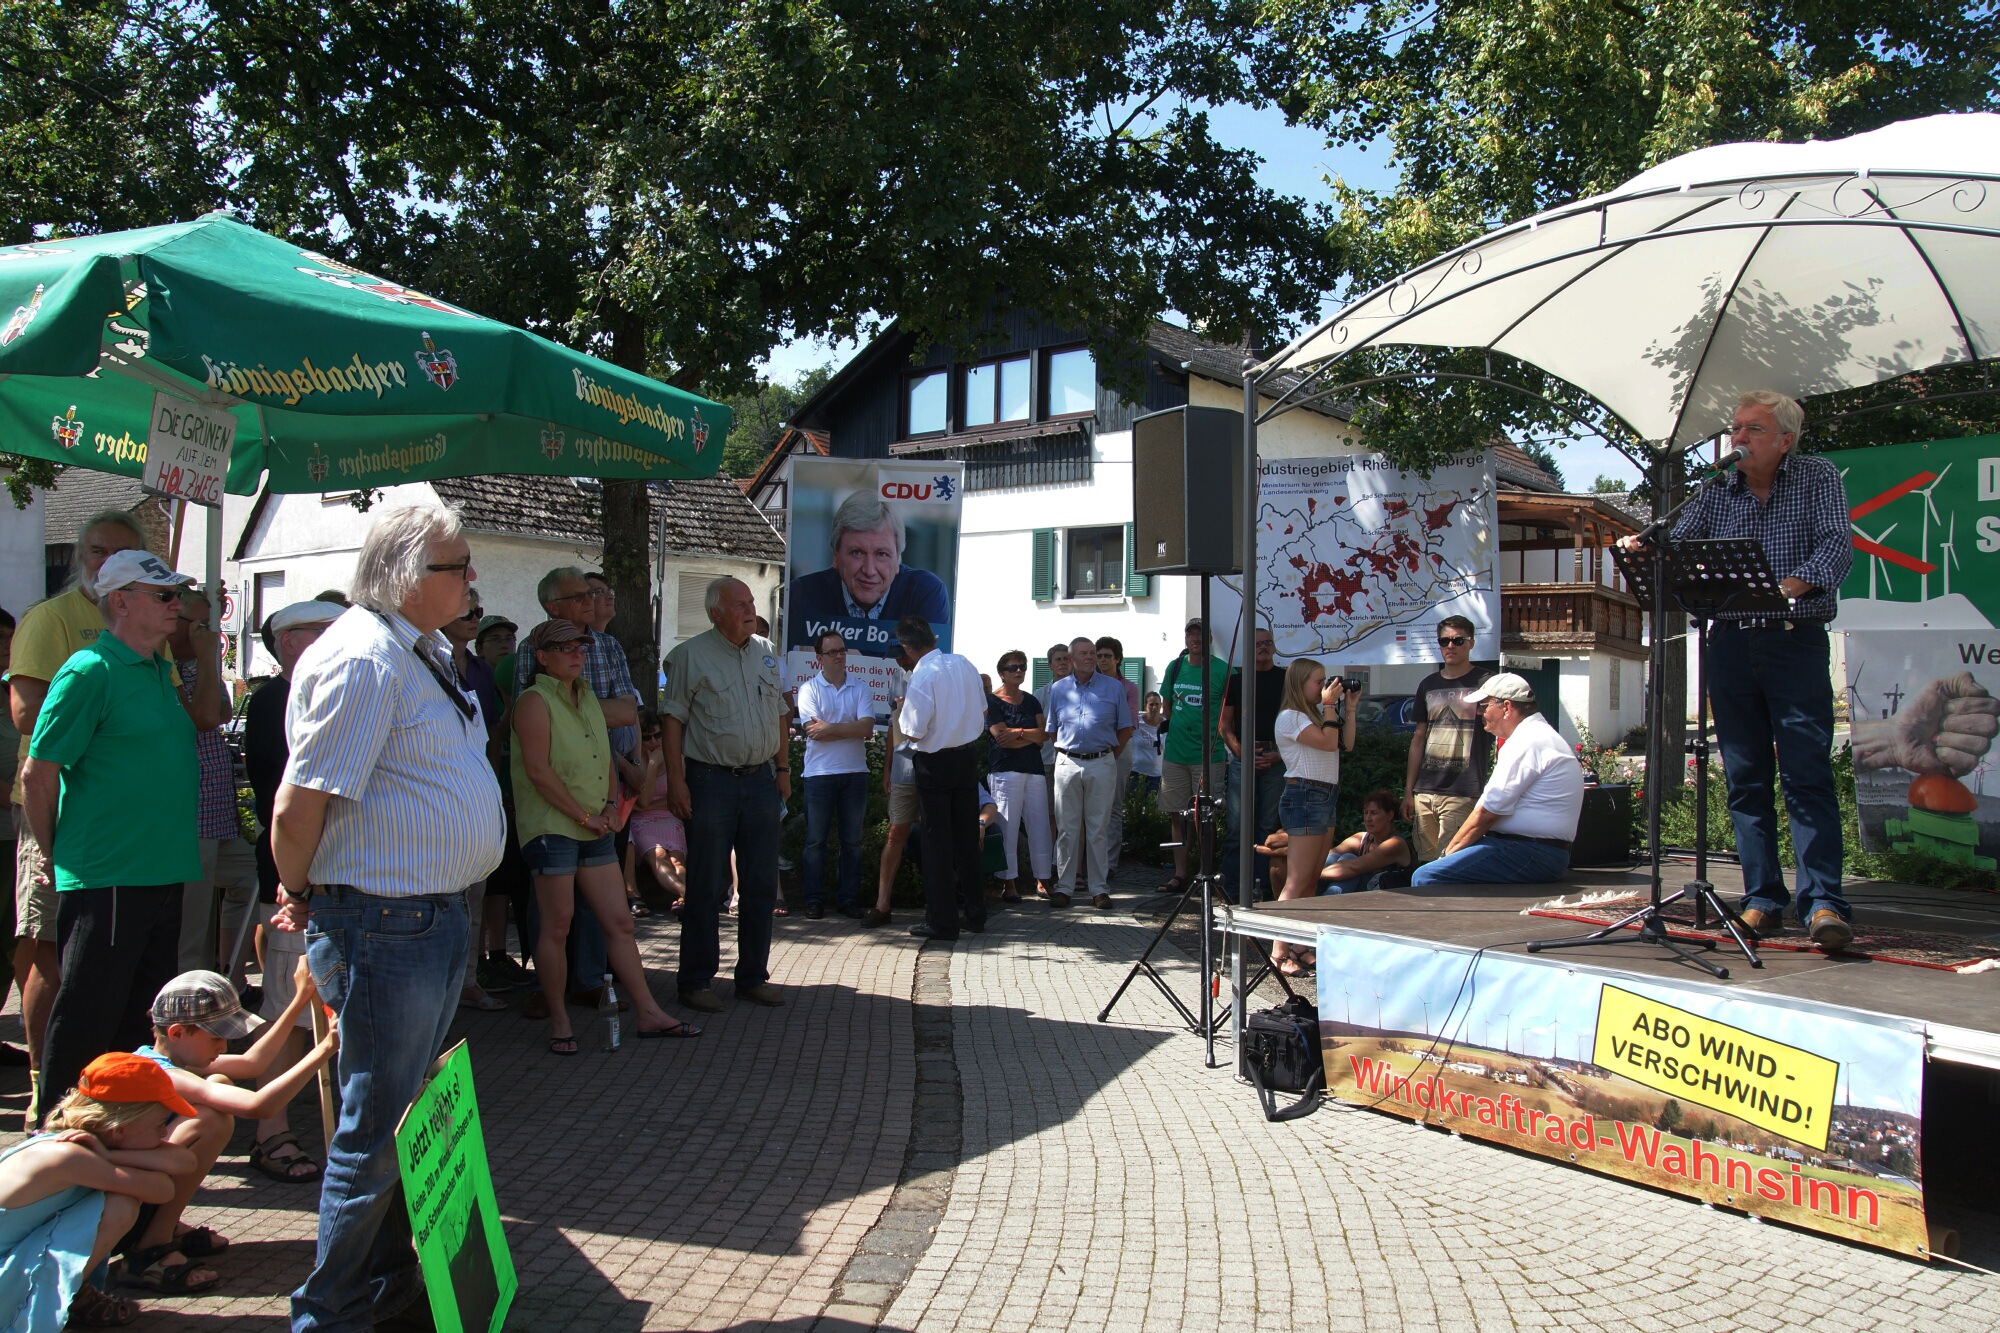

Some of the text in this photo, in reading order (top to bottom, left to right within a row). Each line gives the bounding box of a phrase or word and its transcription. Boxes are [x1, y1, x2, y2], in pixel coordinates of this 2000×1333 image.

[201, 353, 406, 405] Königsbacher
[572, 368, 685, 442] Königsbacher
[181, 414, 231, 452] GRÜNEN
[176, 446, 217, 469] AUF DEM
[1257, 461, 1355, 477] ndustriegebiet
[156, 461, 219, 501] HOLZWEG
[881, 482, 932, 500] CDU
[1263, 488, 1329, 496] Landesentwicklung
[1367, 528, 1409, 536] Schlangenbad
[138, 557, 171, 580] 5
[806, 620, 863, 641] Volker
[869, 665, 883, 676] die
[869, 679, 884, 689] der
[1632, 1012, 1690, 1048] ABO
[1699, 1033, 1777, 1079] WIND
[1611, 1035, 1813, 1129] VERSCHWIND!
[408, 1120, 431, 1174] Jetzt
[1349, 1054, 1879, 1226] Windkraftrad-Wahnsinn
[412, 1190, 426, 1218] Keine
[424, 1172, 435, 1197] 200
[418, 1220, 430, 1248] Bad
